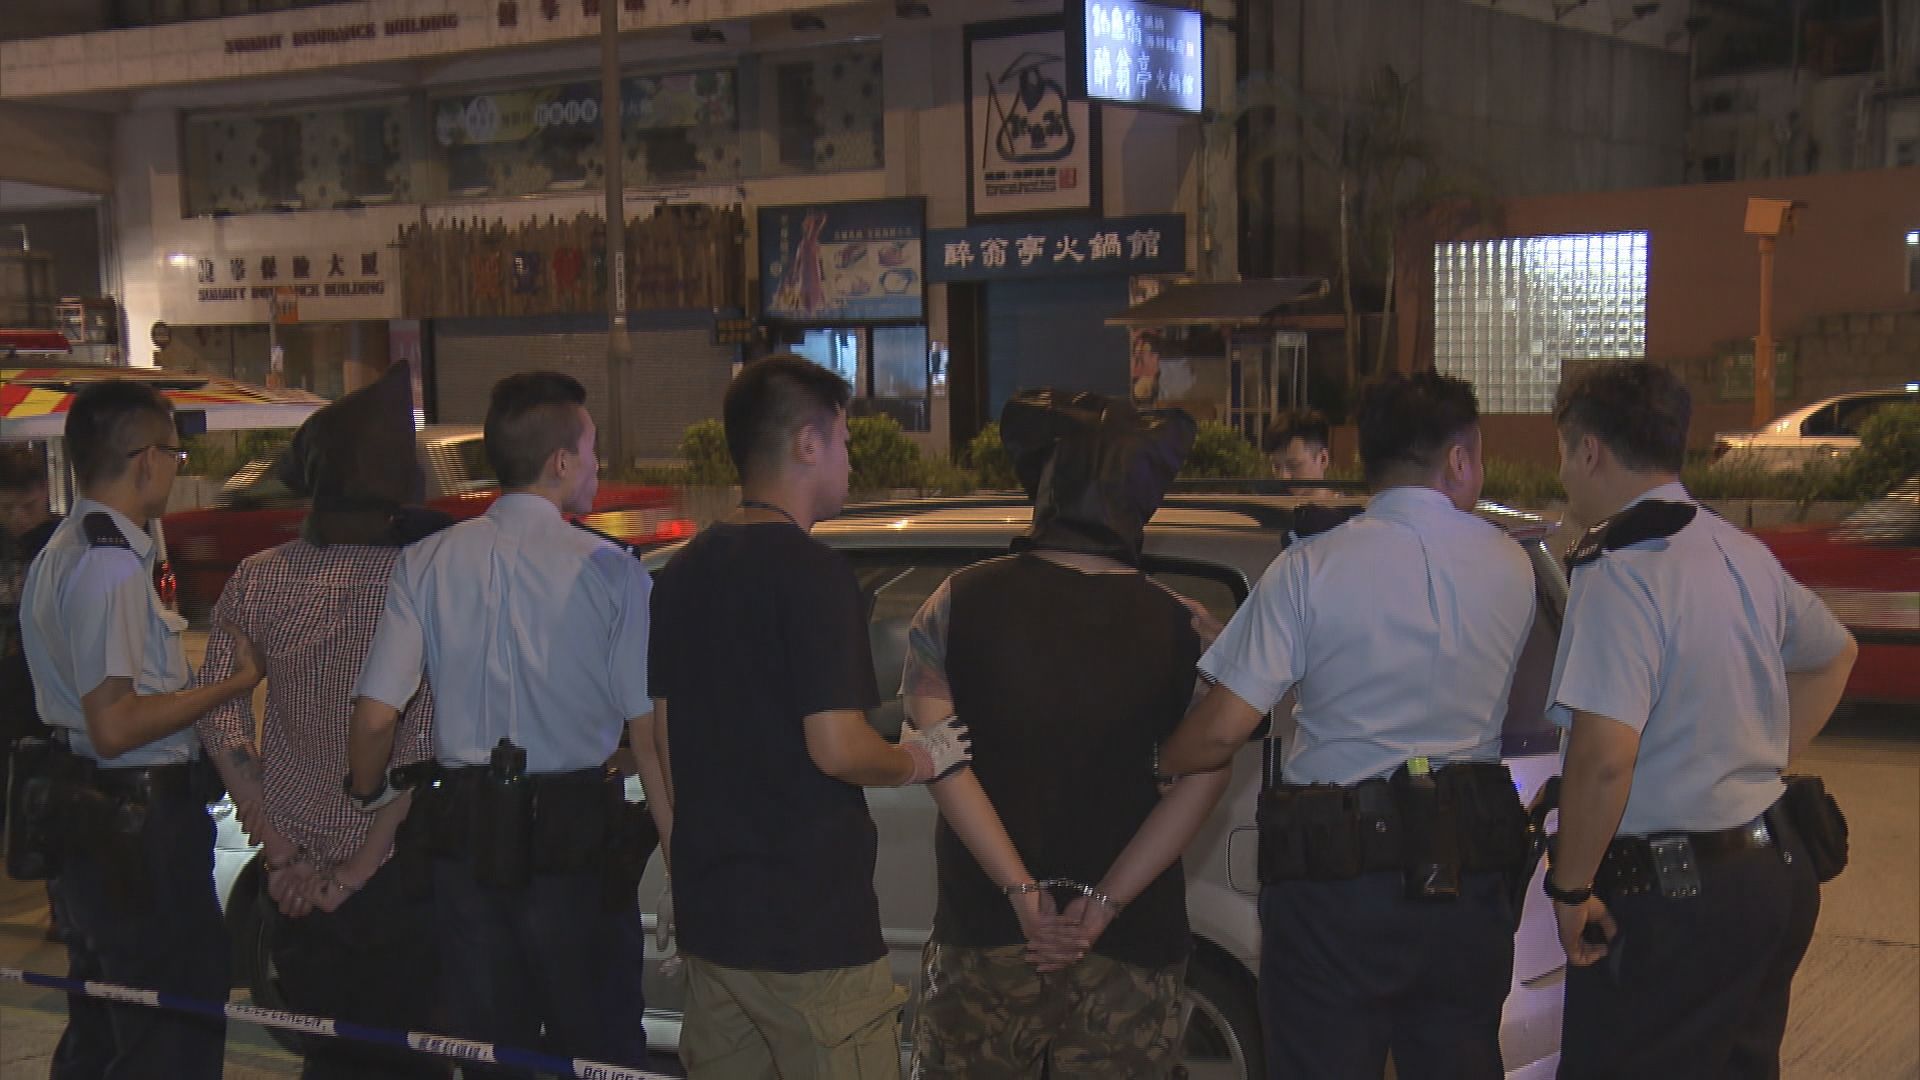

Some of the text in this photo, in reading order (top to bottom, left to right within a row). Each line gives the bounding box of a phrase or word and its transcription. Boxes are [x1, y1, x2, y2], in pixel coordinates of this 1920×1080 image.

[944, 229, 1161, 268] 醉翁亭火鍋館
